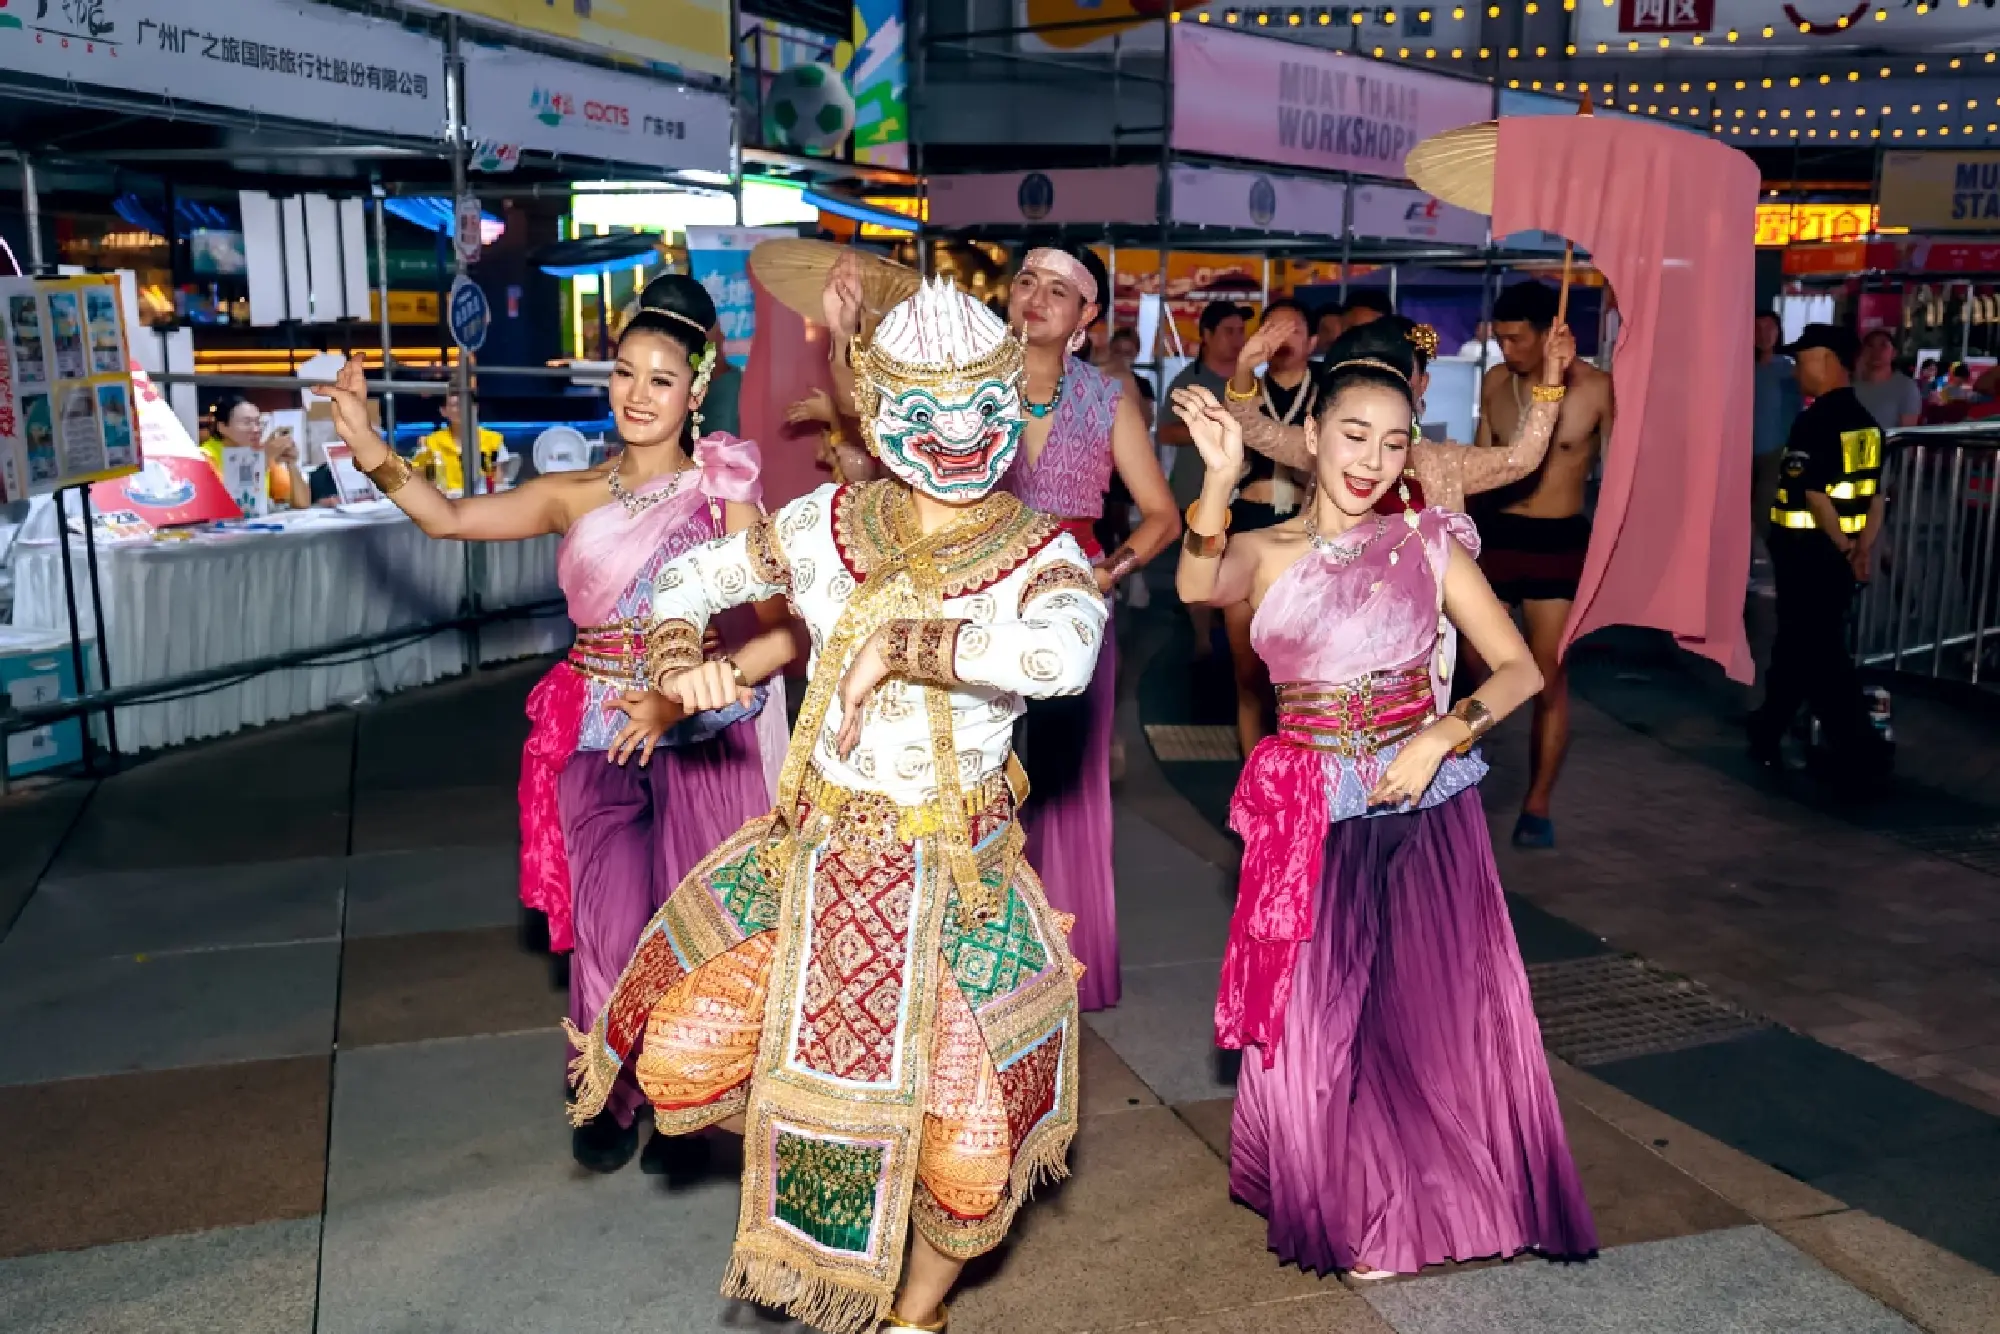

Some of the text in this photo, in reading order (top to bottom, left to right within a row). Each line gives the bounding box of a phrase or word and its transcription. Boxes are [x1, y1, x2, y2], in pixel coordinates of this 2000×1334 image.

[138, 18, 428, 99] 广州广之旅国际旅行社股份有限公司
[1279, 61, 1348, 111] MUAY
